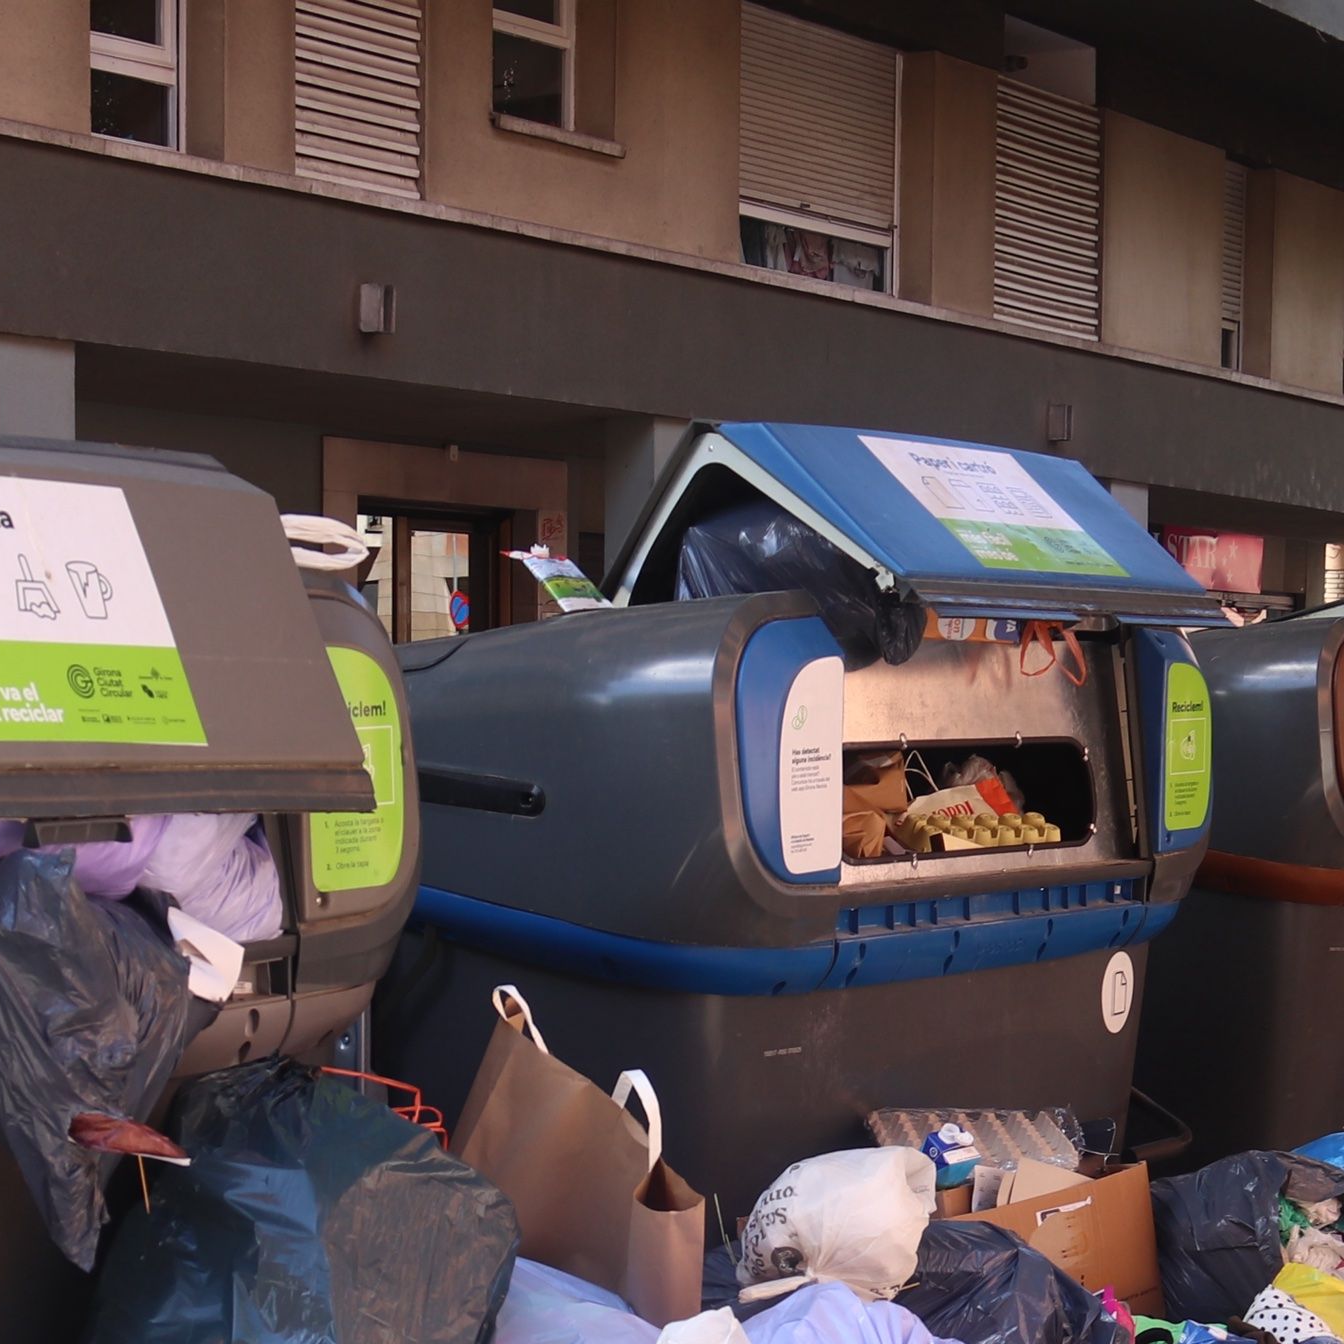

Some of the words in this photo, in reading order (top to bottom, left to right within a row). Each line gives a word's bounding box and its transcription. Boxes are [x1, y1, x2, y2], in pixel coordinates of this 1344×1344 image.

[908, 452, 947, 471] Paper
[1167, 533, 1218, 569] STAR
[94, 667, 122, 678] Girona
[96, 677, 123, 687] Ciutat
[1, 686, 21, 701] va
[24, 682, 39, 701] el
[100, 687, 133, 698] Circular
[3, 704, 64, 723] reciclar
[348, 701, 386, 718] iclem!
[1172, 701, 1203, 713] Reciclem!
[932, 801, 974, 816] ORDI
